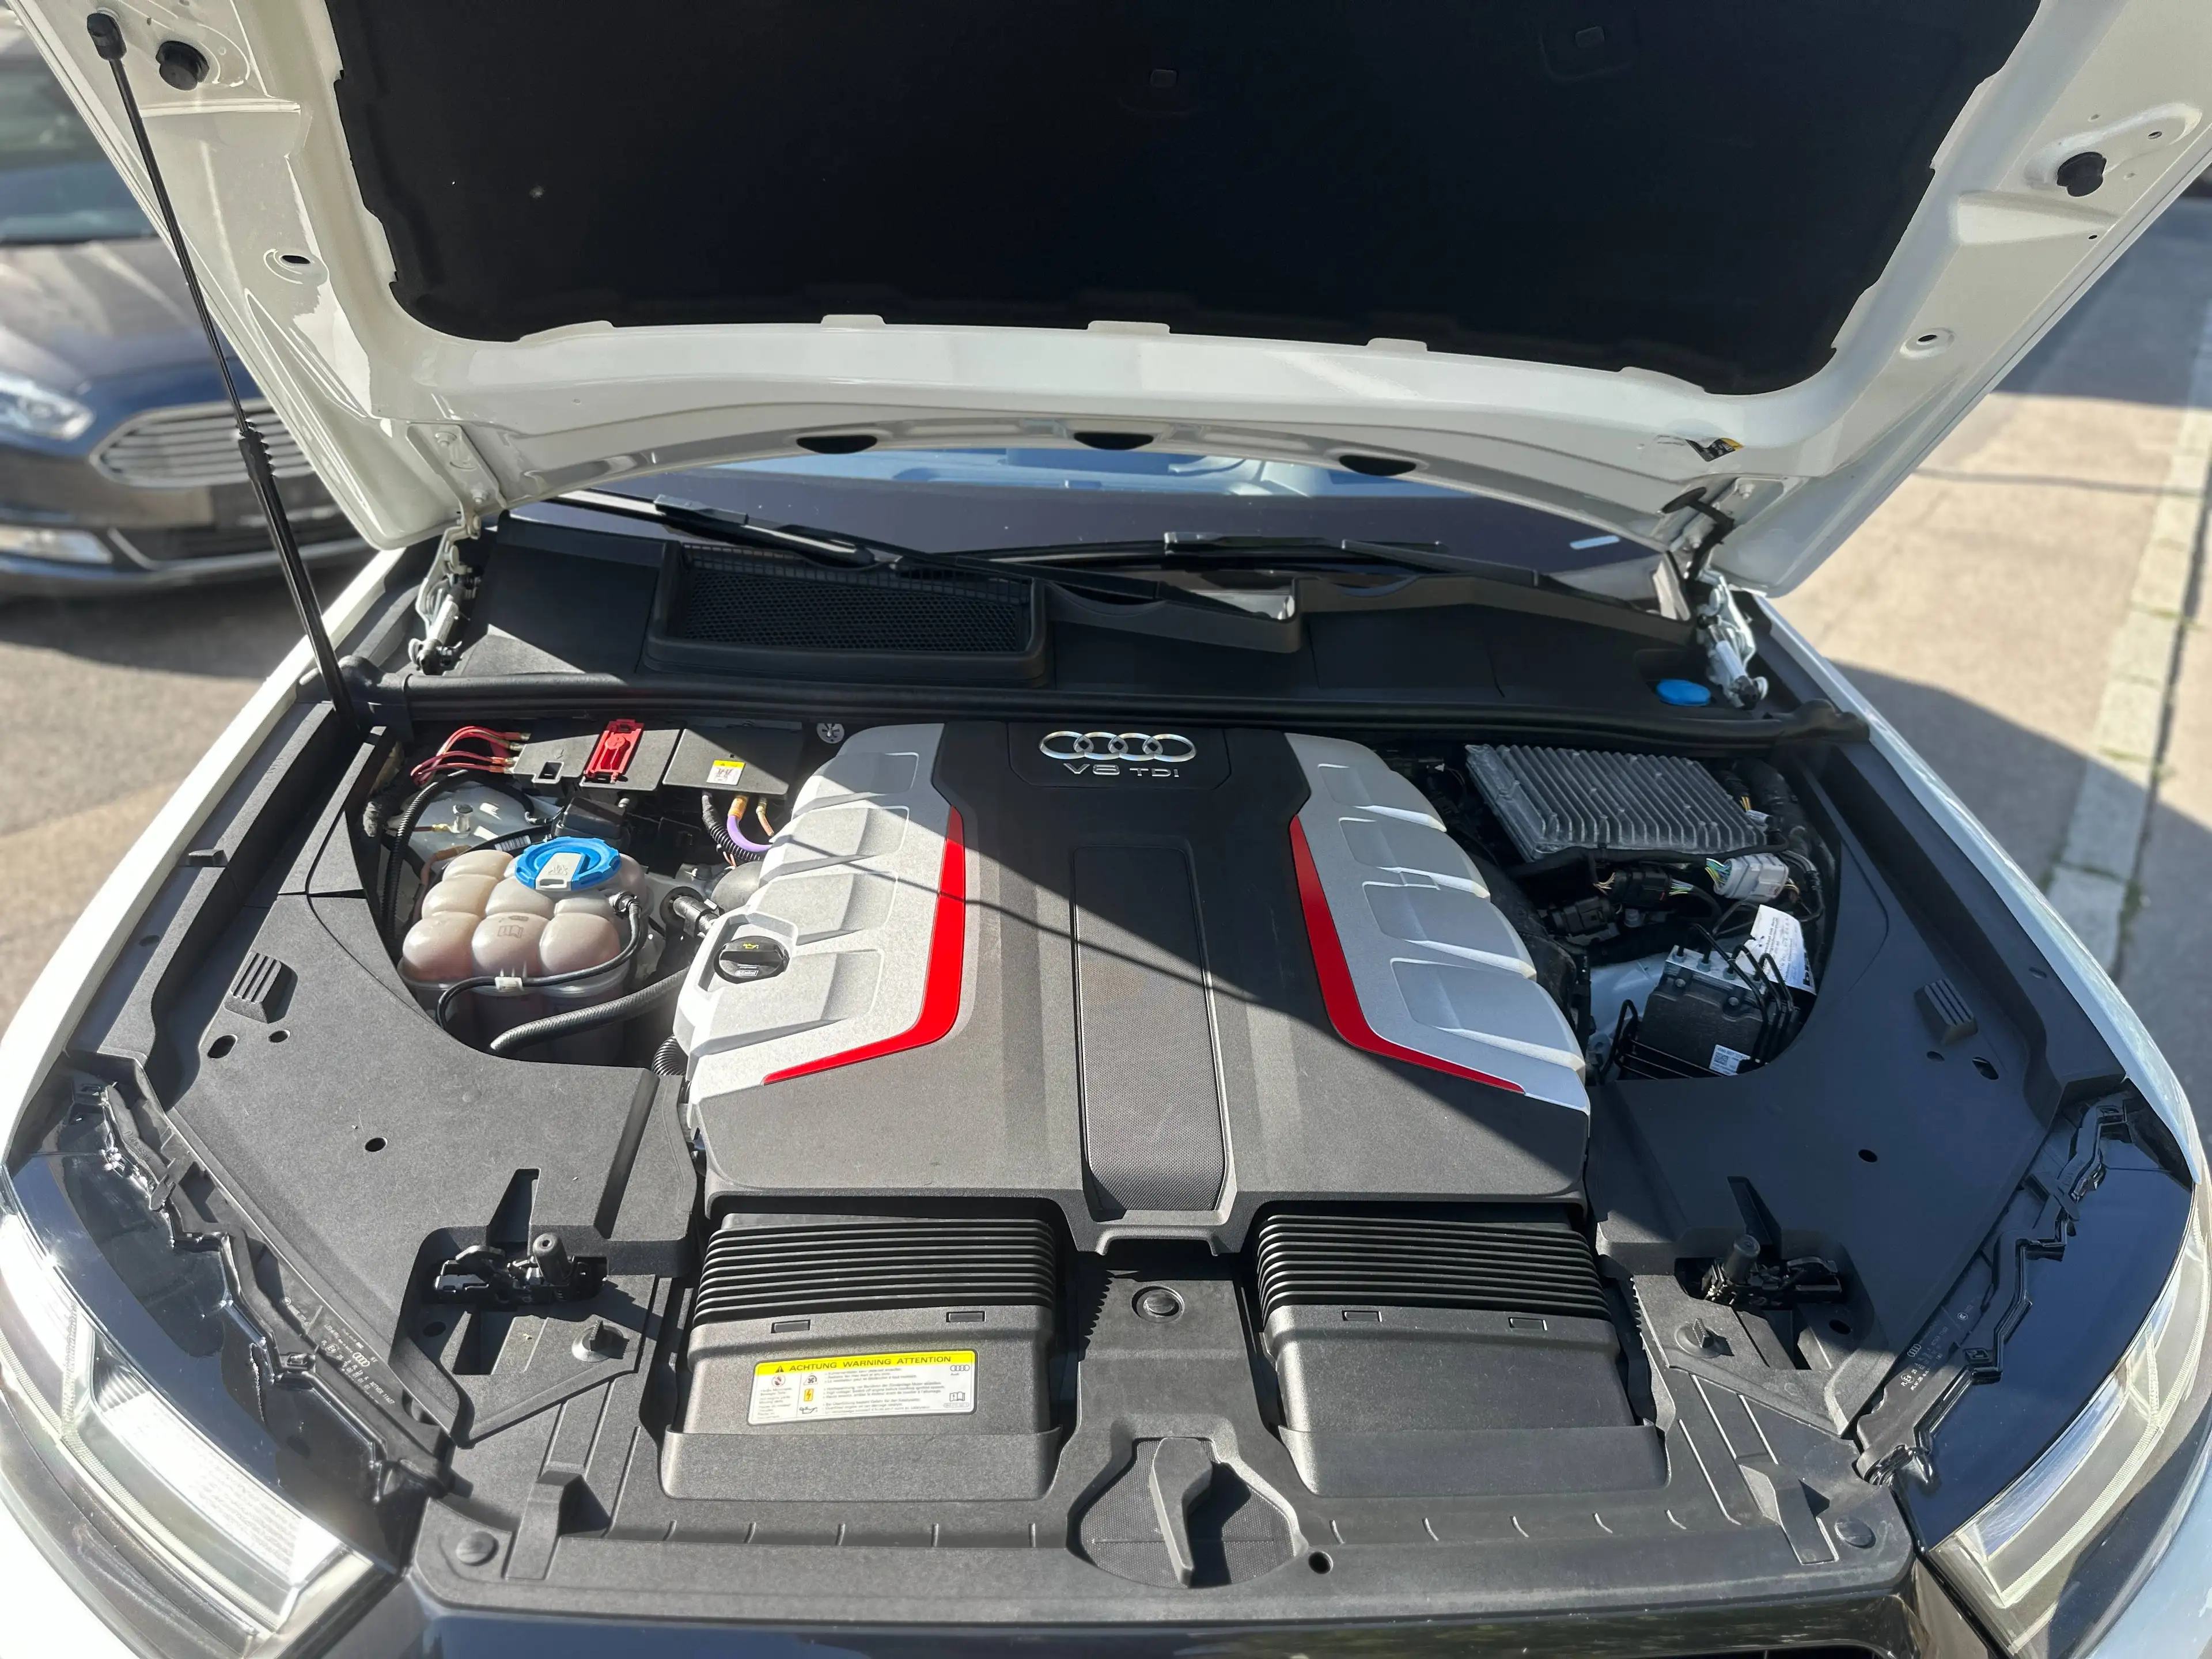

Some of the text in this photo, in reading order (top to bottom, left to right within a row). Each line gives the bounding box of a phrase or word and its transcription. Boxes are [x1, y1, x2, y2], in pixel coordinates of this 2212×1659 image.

[1063, 763, 1120, 776] V8
[789, 1355, 951, 1372] ACHTUNG WARNING ATTENTION
